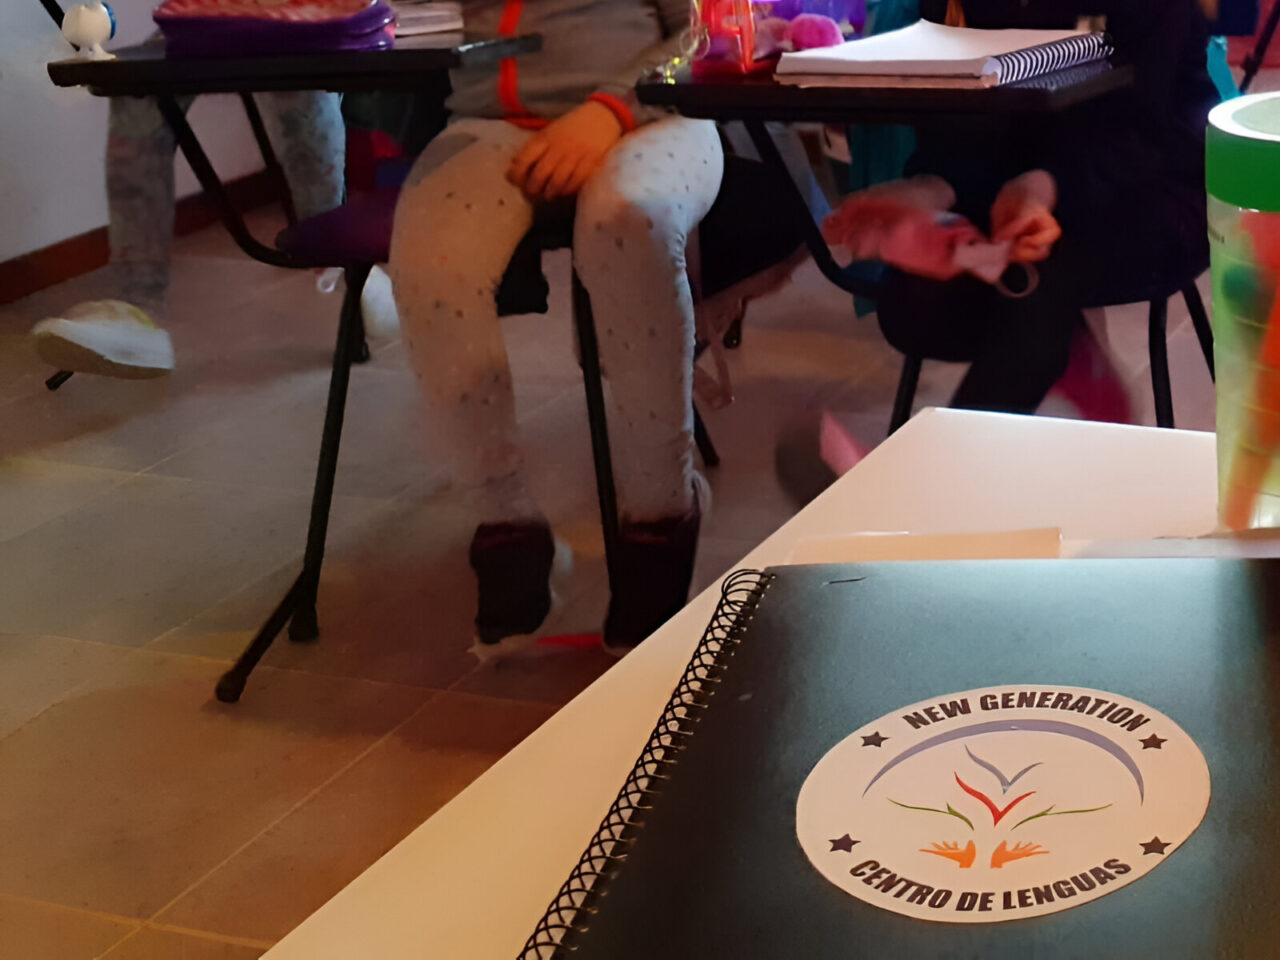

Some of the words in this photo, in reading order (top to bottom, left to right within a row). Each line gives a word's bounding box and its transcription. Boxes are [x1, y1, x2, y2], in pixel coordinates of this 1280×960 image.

[901, 698, 971, 729] NEW
[980, 691, 1152, 732] GENERATION
[849, 859, 952, 910] CENTRO
[955, 892, 994, 912] DE
[1003, 857, 1132, 911] LENGUAS
